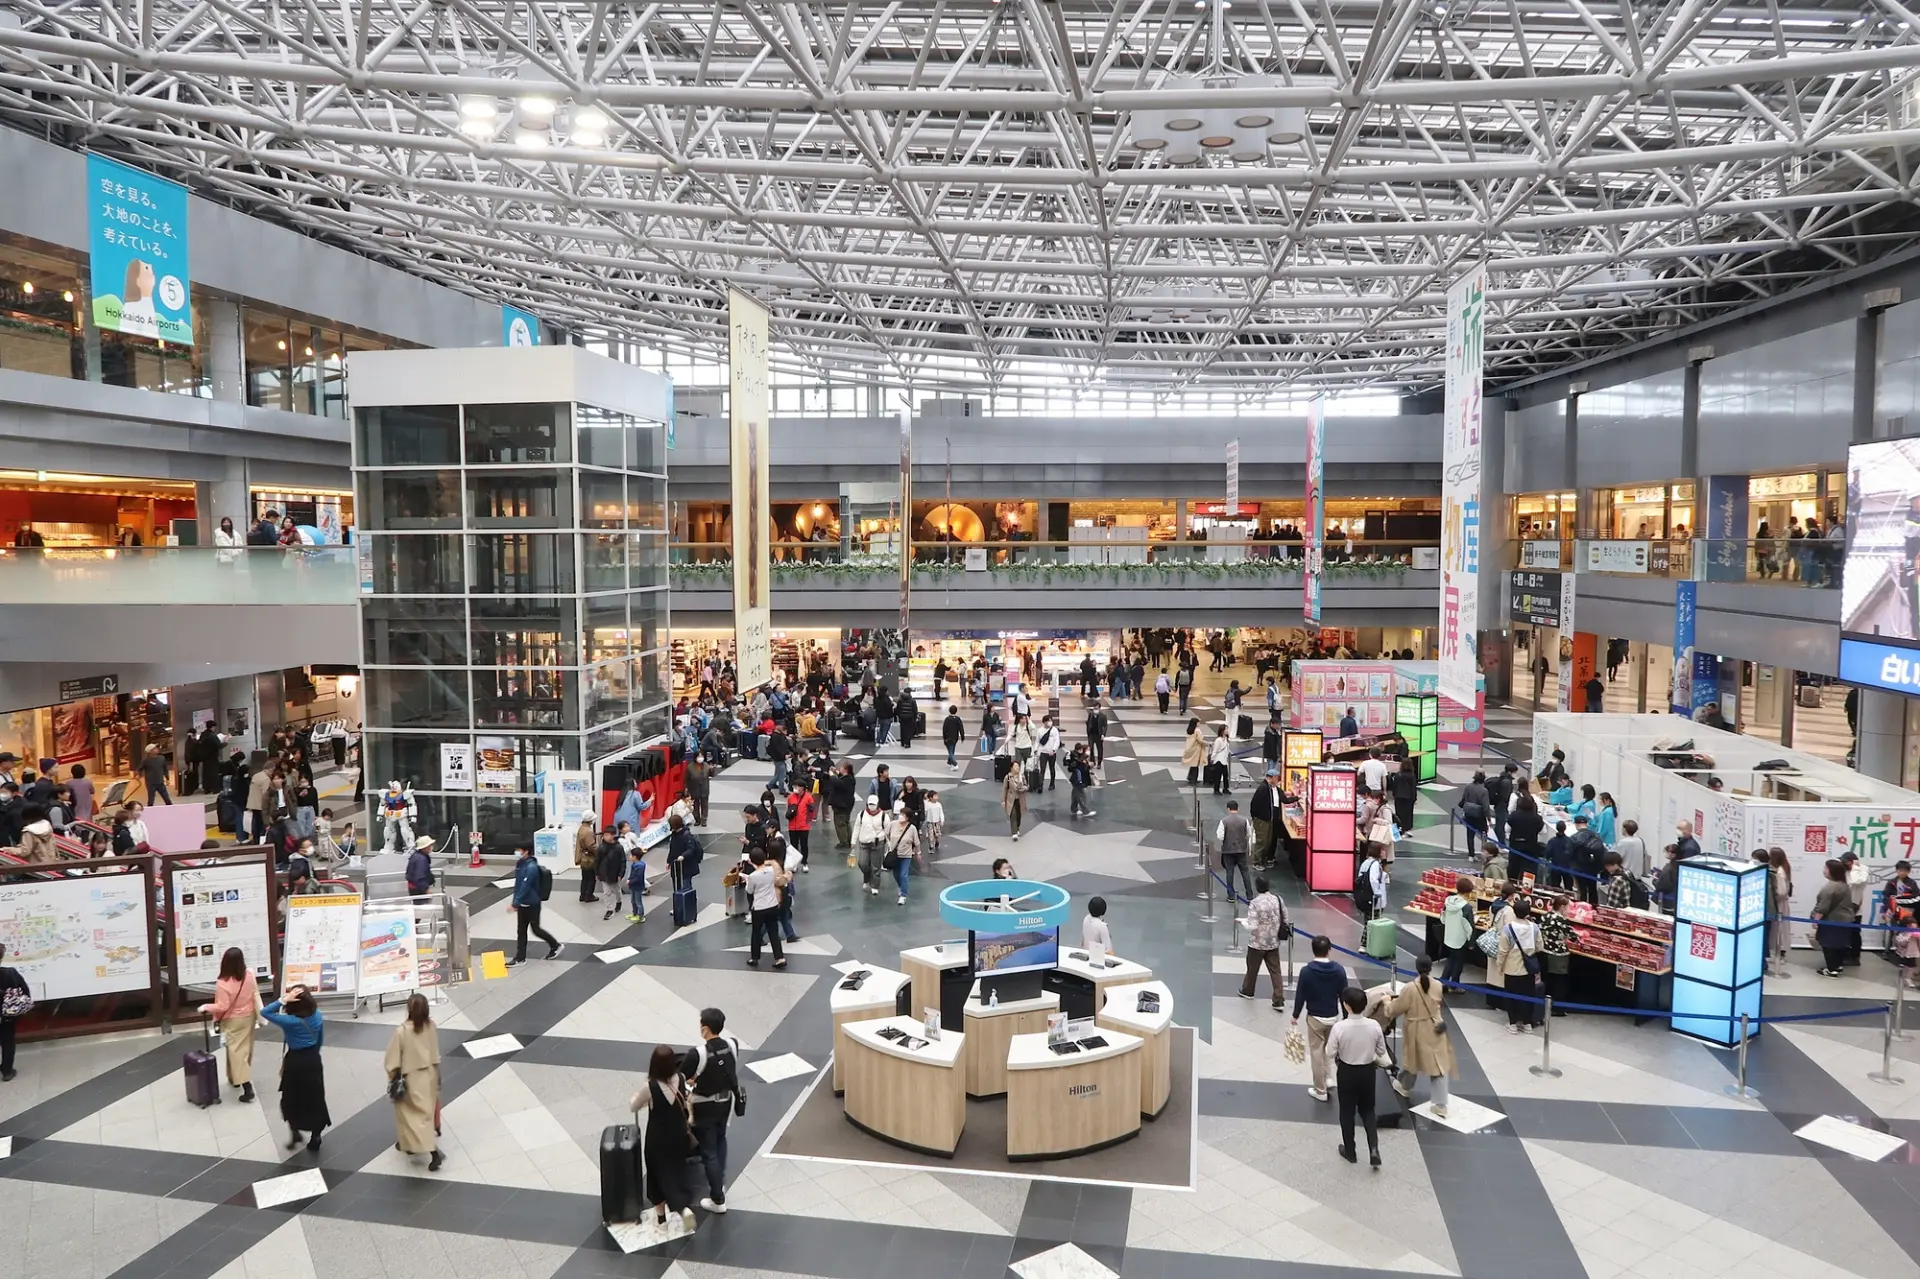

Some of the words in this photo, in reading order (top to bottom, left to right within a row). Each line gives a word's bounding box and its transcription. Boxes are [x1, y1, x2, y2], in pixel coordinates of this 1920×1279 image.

[100, 178, 157, 210] 空を見る。
[102, 203, 178, 240] 大地のことを、
[103, 227, 168, 259] 考えている。
[105, 307, 145, 324] Hokkaido
[147, 315, 180, 332] Airports
[1720, 490, 1734, 537] market
[1718, 539, 1737, 567] Sky
[1315, 801, 1353, 809] OKINAWA
[1317, 787, 1346, 802] 沖縄
[1681, 888, 1724, 912] 東日本
[292, 908, 307, 918] 3F
[1019, 916, 1043, 926] Hilton
[1679, 907, 1734, 929] EASTERN
[1069, 1084, 1097, 1096] Hilton
